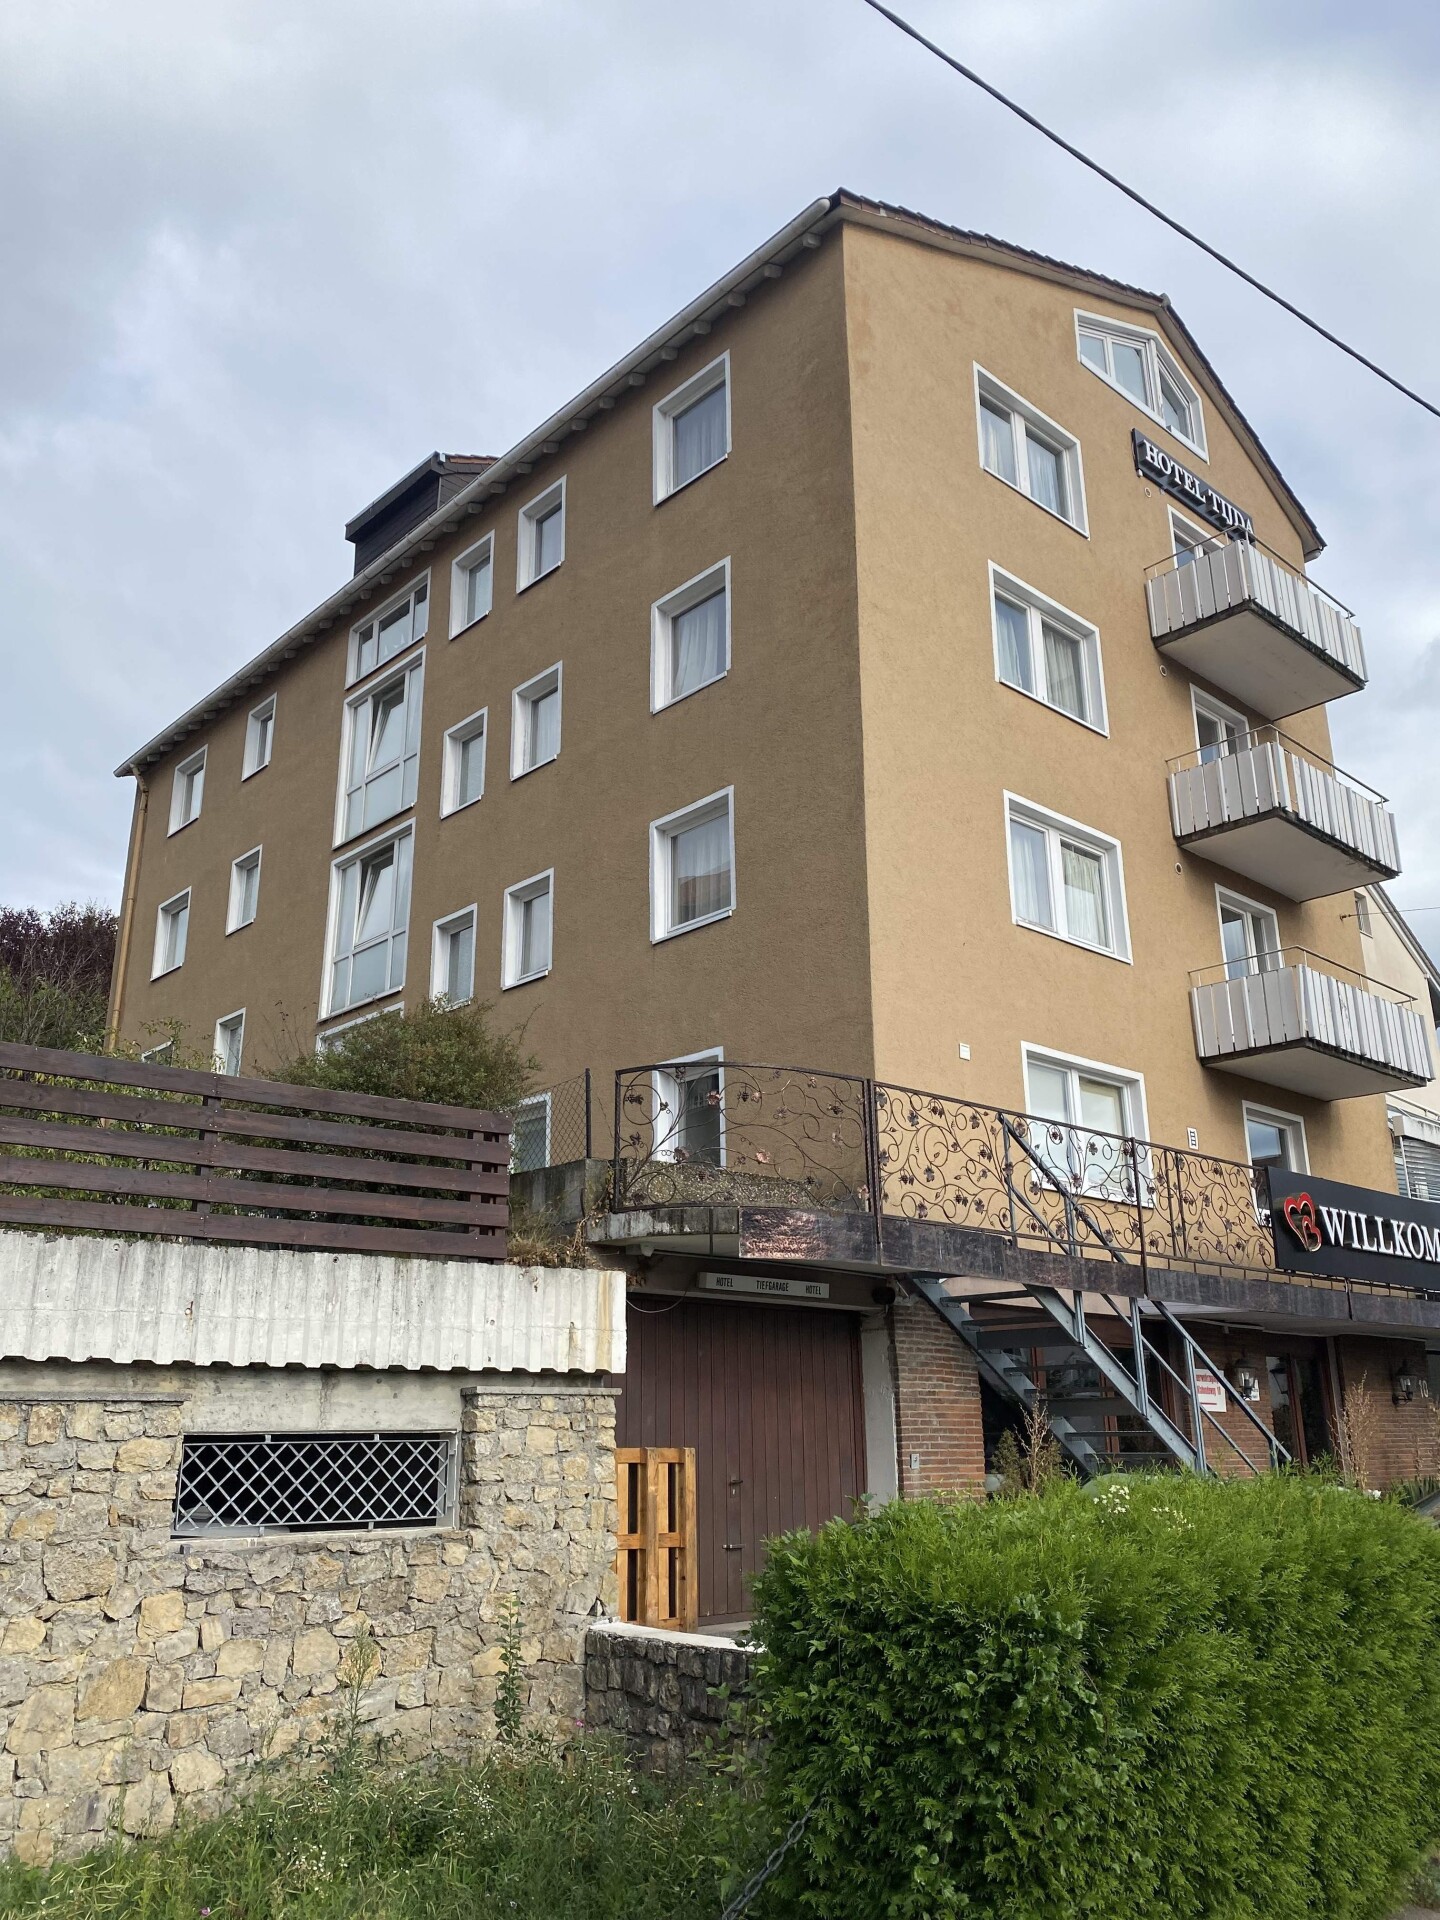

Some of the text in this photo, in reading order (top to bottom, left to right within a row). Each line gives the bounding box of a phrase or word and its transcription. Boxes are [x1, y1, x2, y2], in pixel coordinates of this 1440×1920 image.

[1143, 439, 1206, 504] HOTEL
[1319, 1205, 1440, 1263] WILLKOM
[716, 1277, 822, 1295] HOTEL TIEFGARAGE HOTEL
[1418, 1379, 1429, 1398] 10
